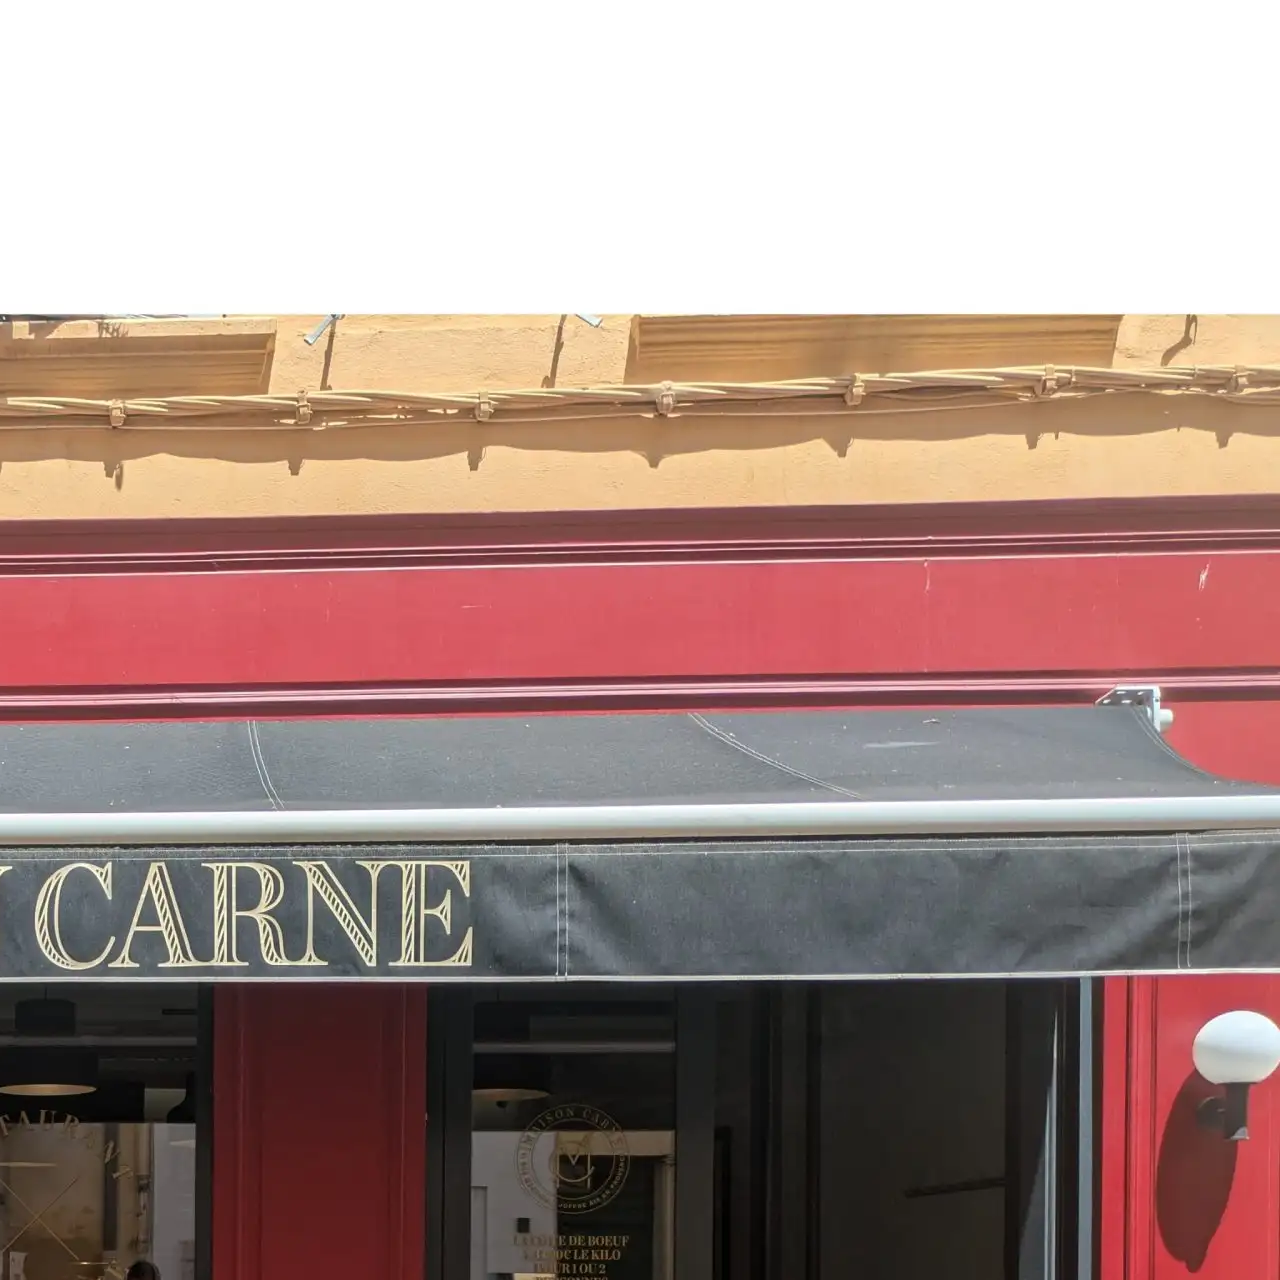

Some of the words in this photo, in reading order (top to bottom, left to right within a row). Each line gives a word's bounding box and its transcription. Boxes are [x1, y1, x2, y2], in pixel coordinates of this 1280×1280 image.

[34, 859, 474, 969] CARNE
[569, 1235, 586, 1247] DE
[588, 1235, 630, 1247] BOEUF
[574, 1249, 589, 1261] LE
[591, 1249, 621, 1261] KILO
[579, 1263, 598, 1274] OU
[598, 1263, 606, 1274] 2
